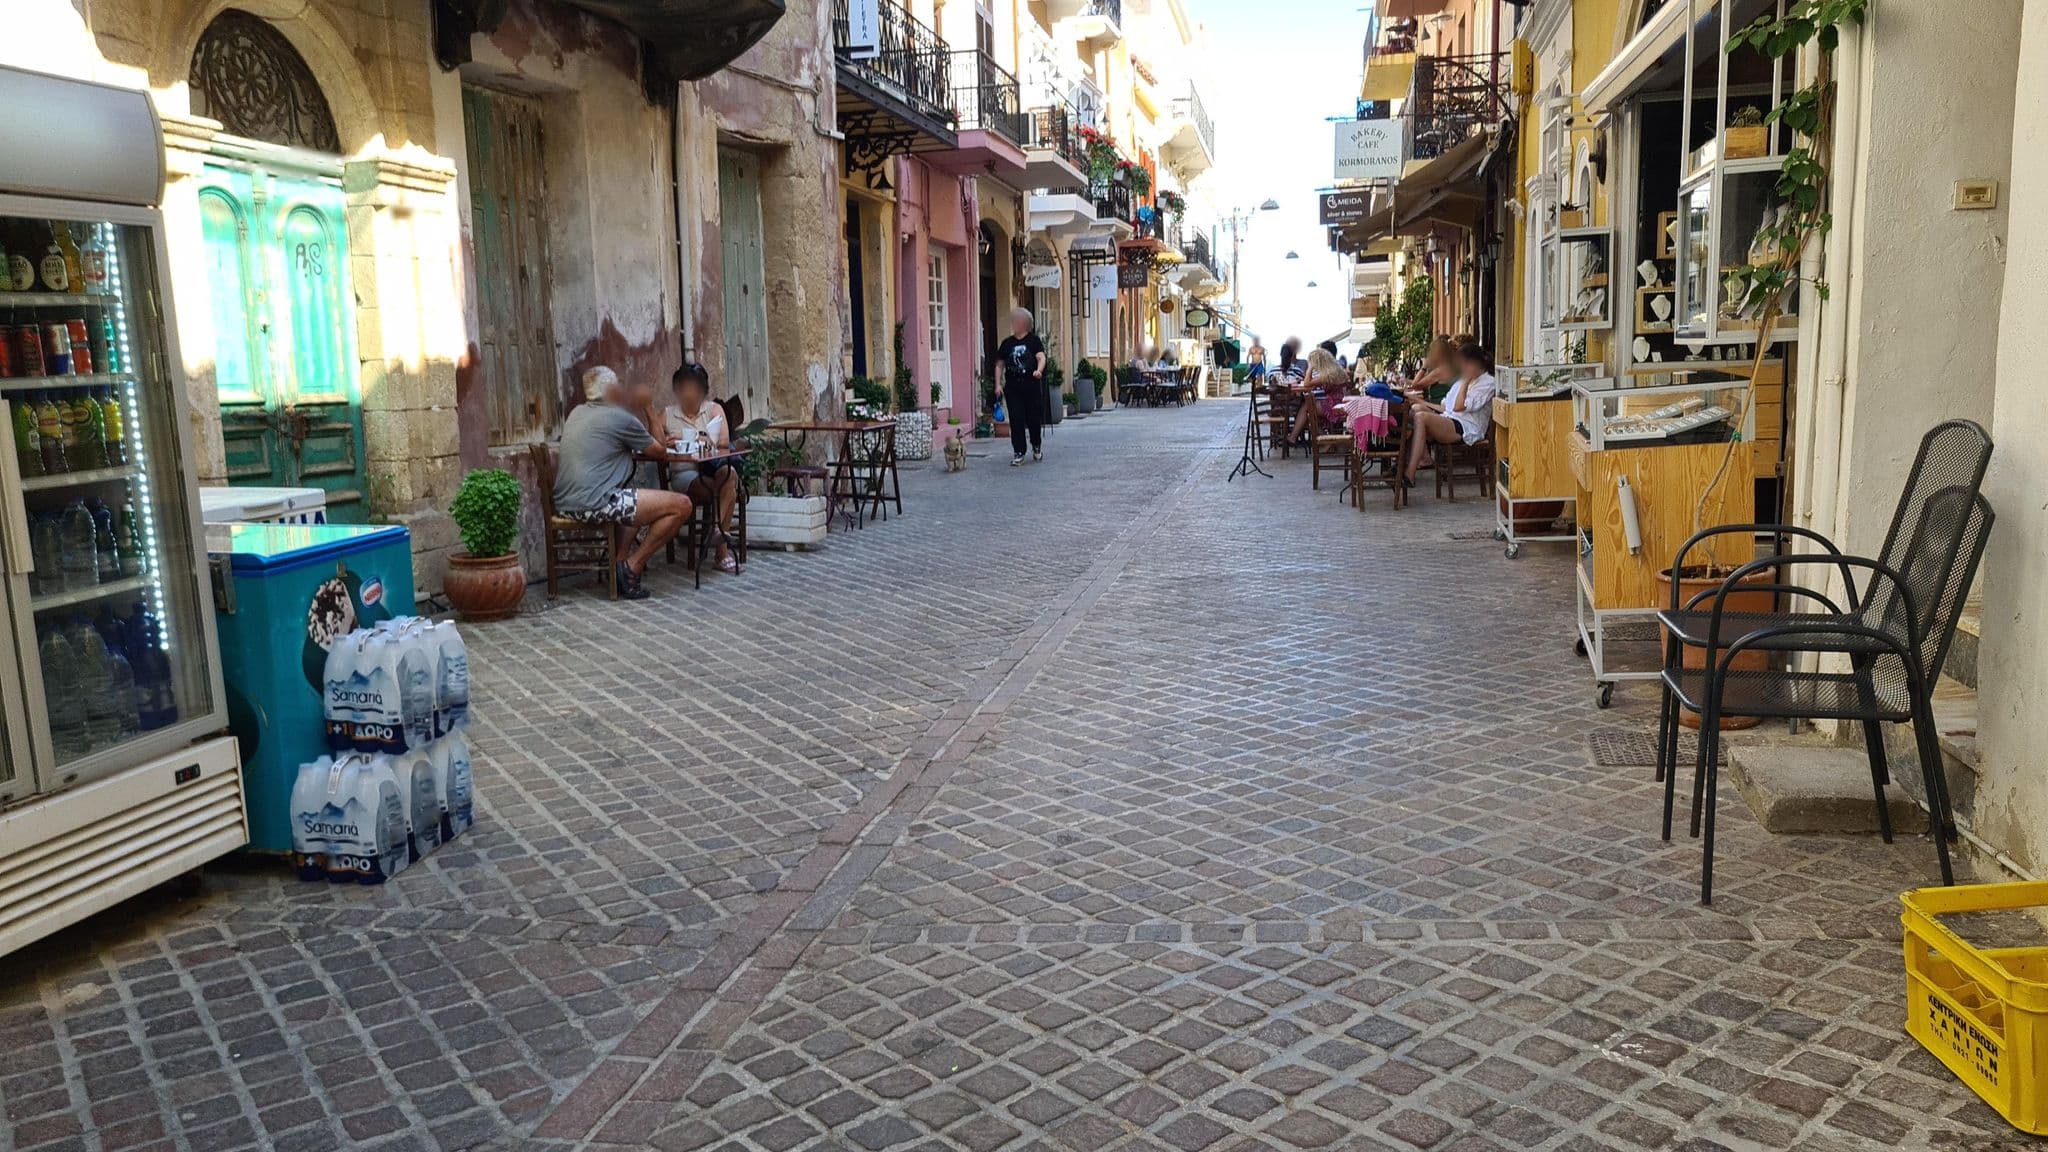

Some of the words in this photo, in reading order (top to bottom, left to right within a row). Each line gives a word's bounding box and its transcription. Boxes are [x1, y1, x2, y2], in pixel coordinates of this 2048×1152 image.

[1350, 127, 1388, 142] BAKERY
[1357, 140, 1379, 149] CAFE
[1338, 155, 1399, 167] KORMORANOS
[1927, 994, 1967, 1033] ΚΕΝΤΡΙΚΗ
[1968, 1026, 1999, 1058] ΕΝΩΣΗ
